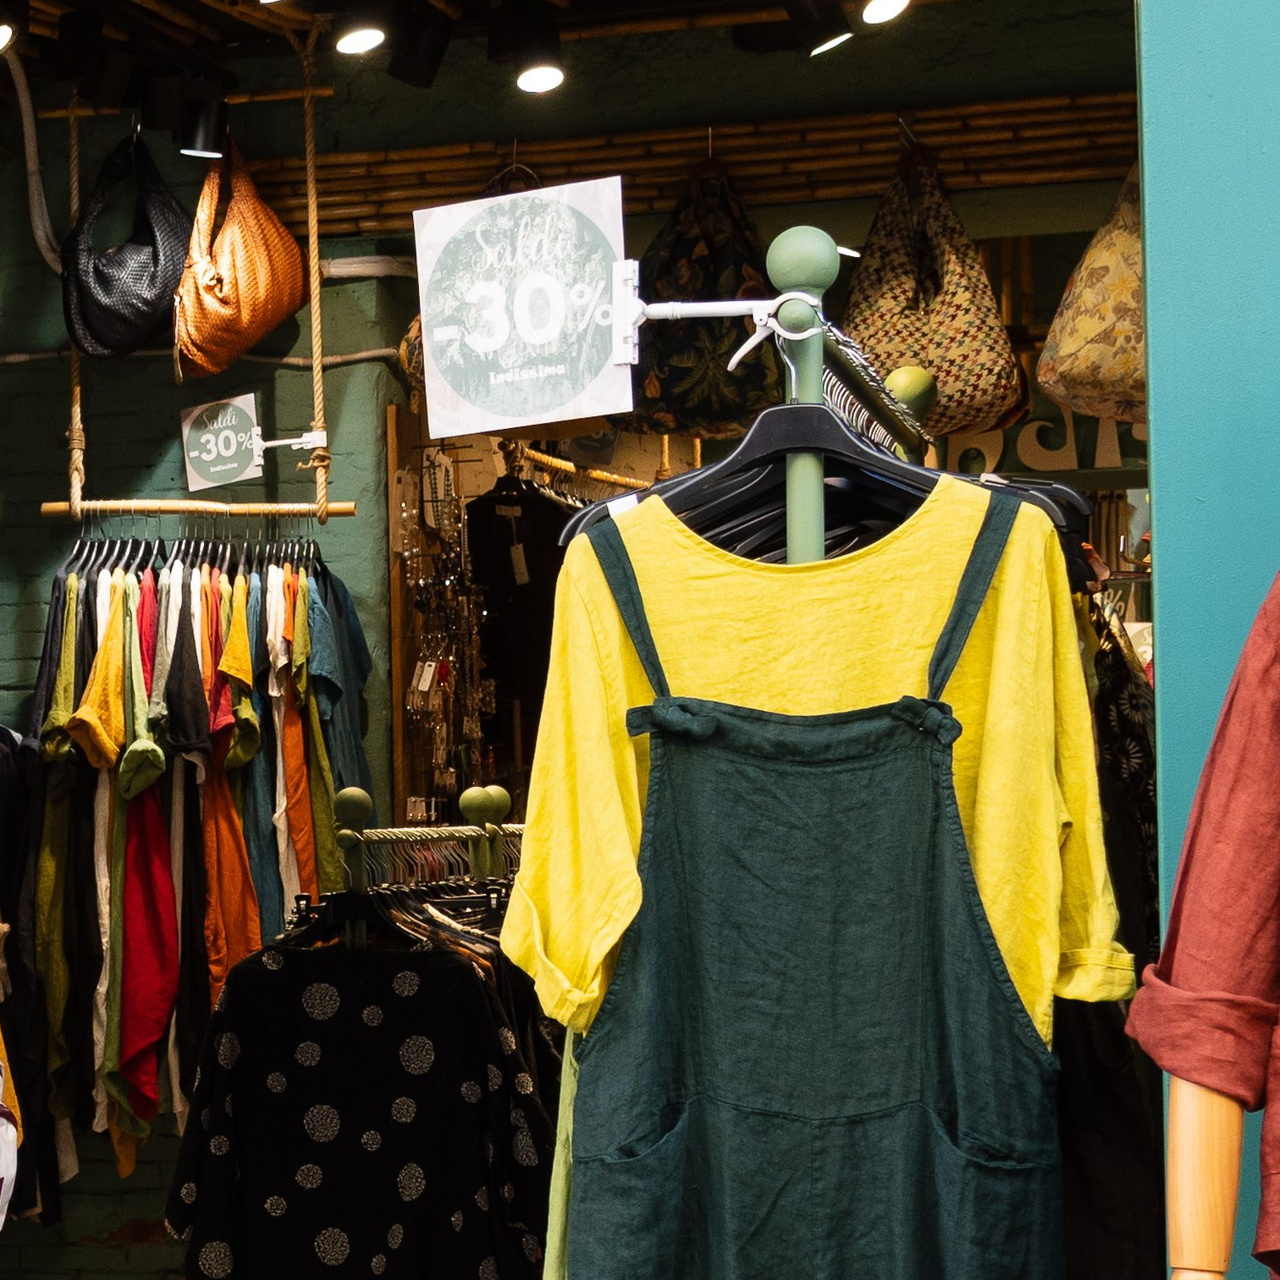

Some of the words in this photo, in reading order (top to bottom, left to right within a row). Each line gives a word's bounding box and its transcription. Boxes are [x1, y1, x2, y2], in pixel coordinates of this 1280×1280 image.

[472, 213, 573, 272] Saldi
[433, 269, 614, 353] -30%
[202, 406, 238, 432] Saldi
[188, 429, 254, 462] -30%
